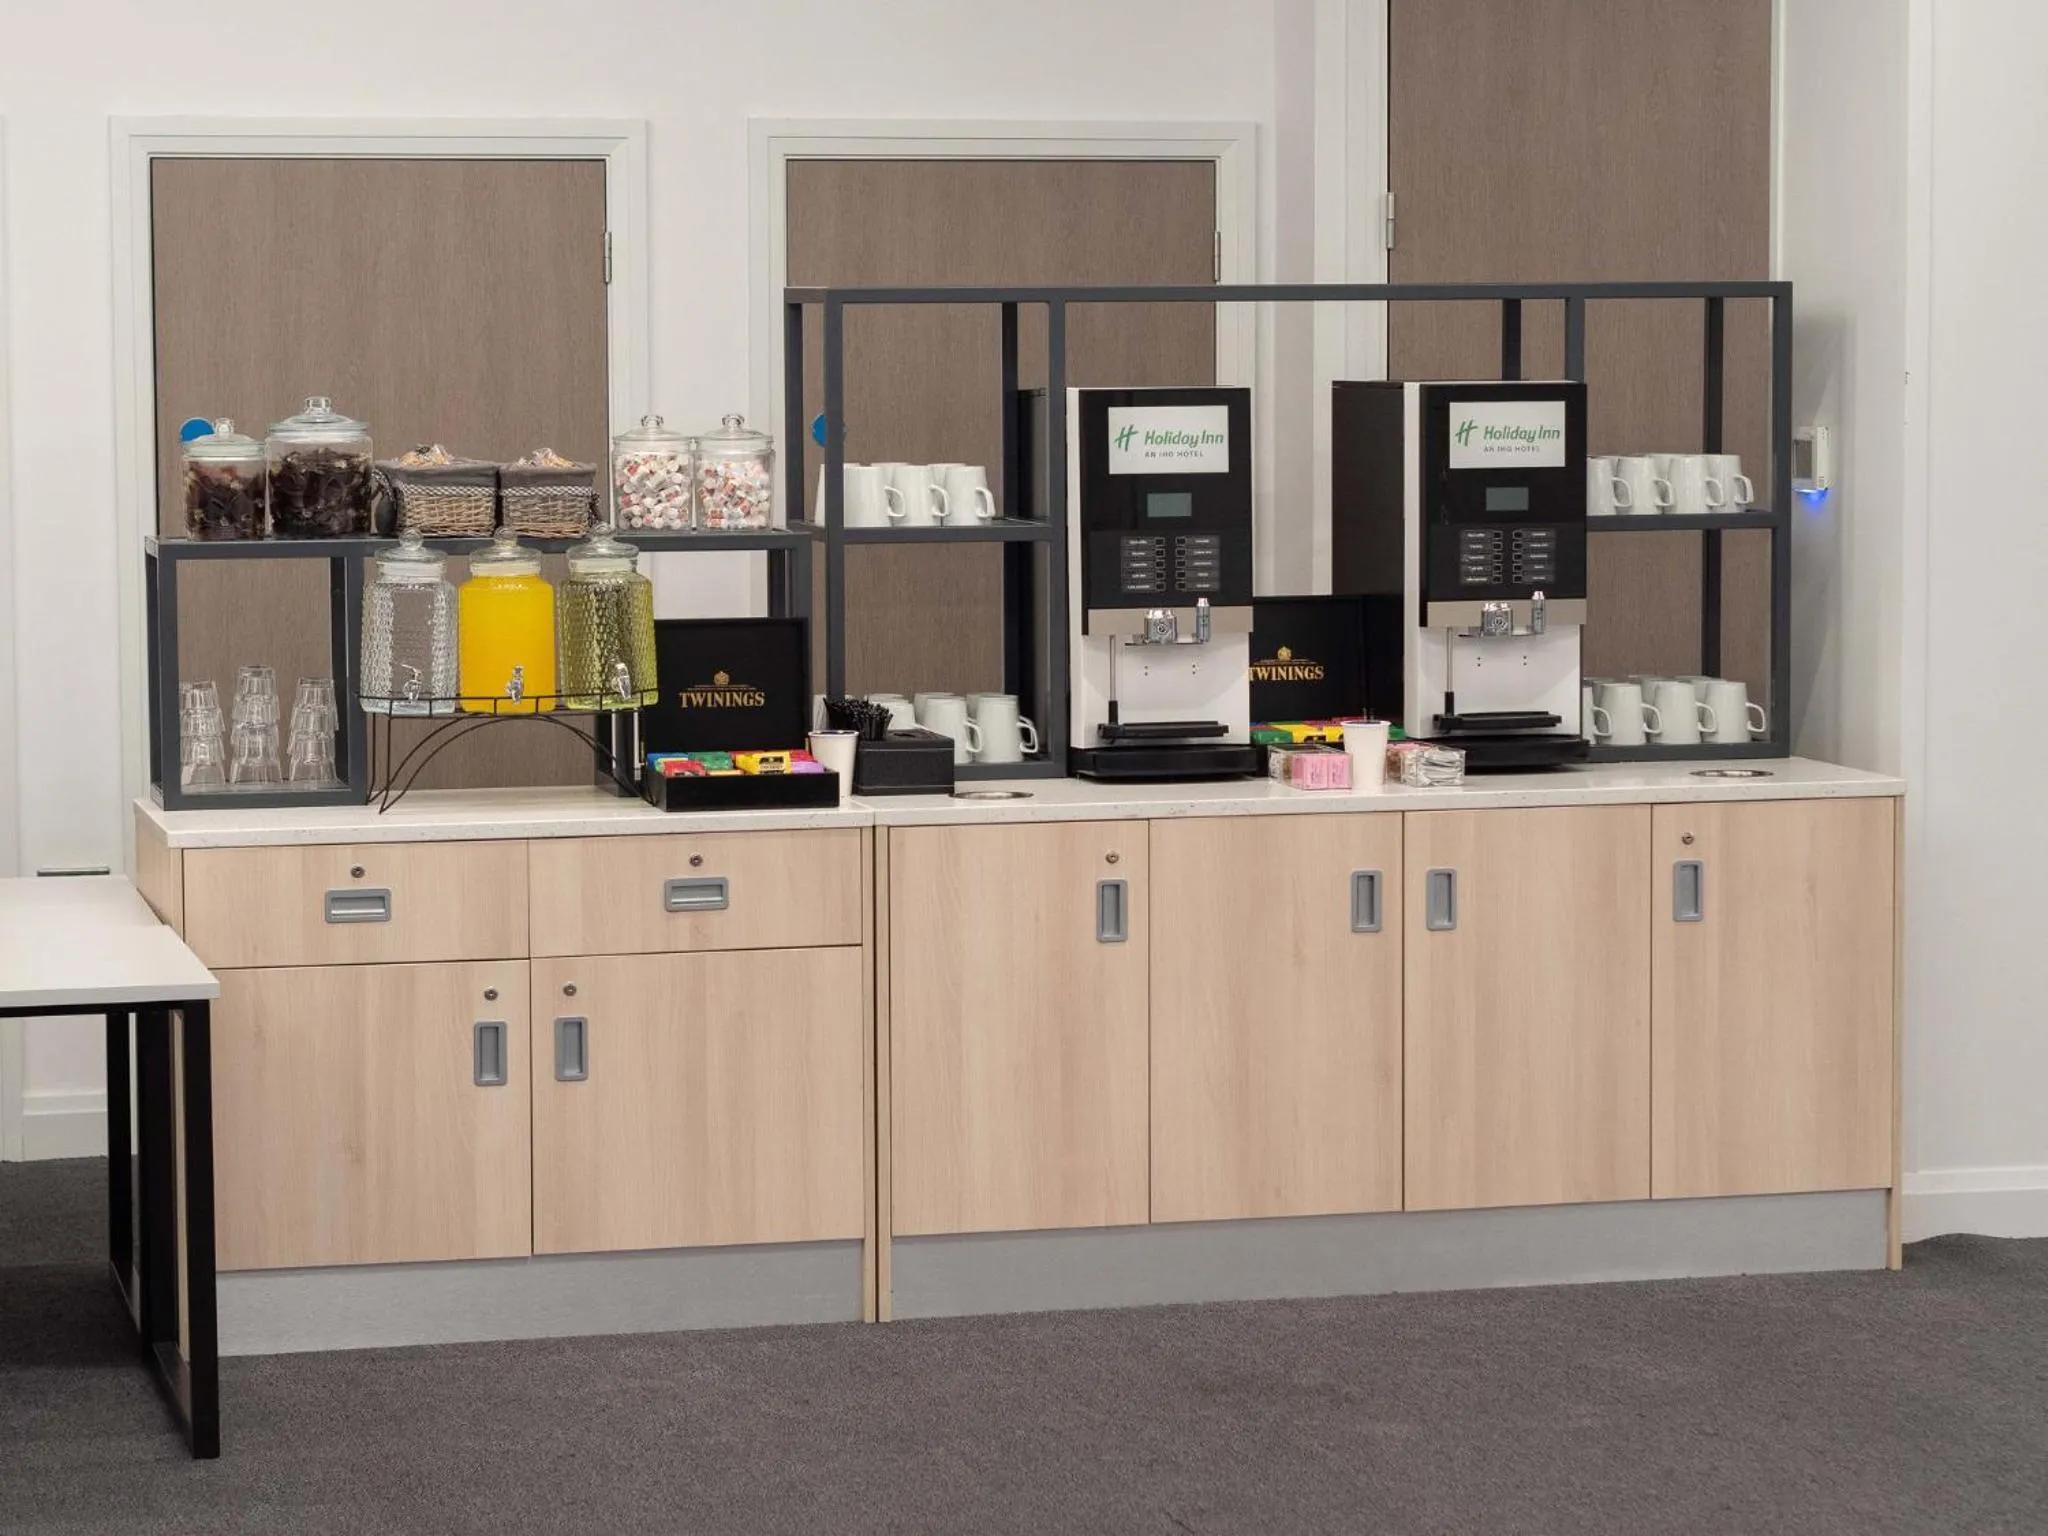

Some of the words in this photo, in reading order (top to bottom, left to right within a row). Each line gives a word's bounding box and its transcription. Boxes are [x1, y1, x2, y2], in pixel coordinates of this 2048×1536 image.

[1144, 430, 1200, 448] Holiday
[1201, 429, 1225, 445] Inn
[1483, 426, 1537, 444] Holiday
[1538, 425, 1560, 440] Inn
[1248, 665, 1324, 681] TWININGS
[679, 691, 765, 708] TWININGS
